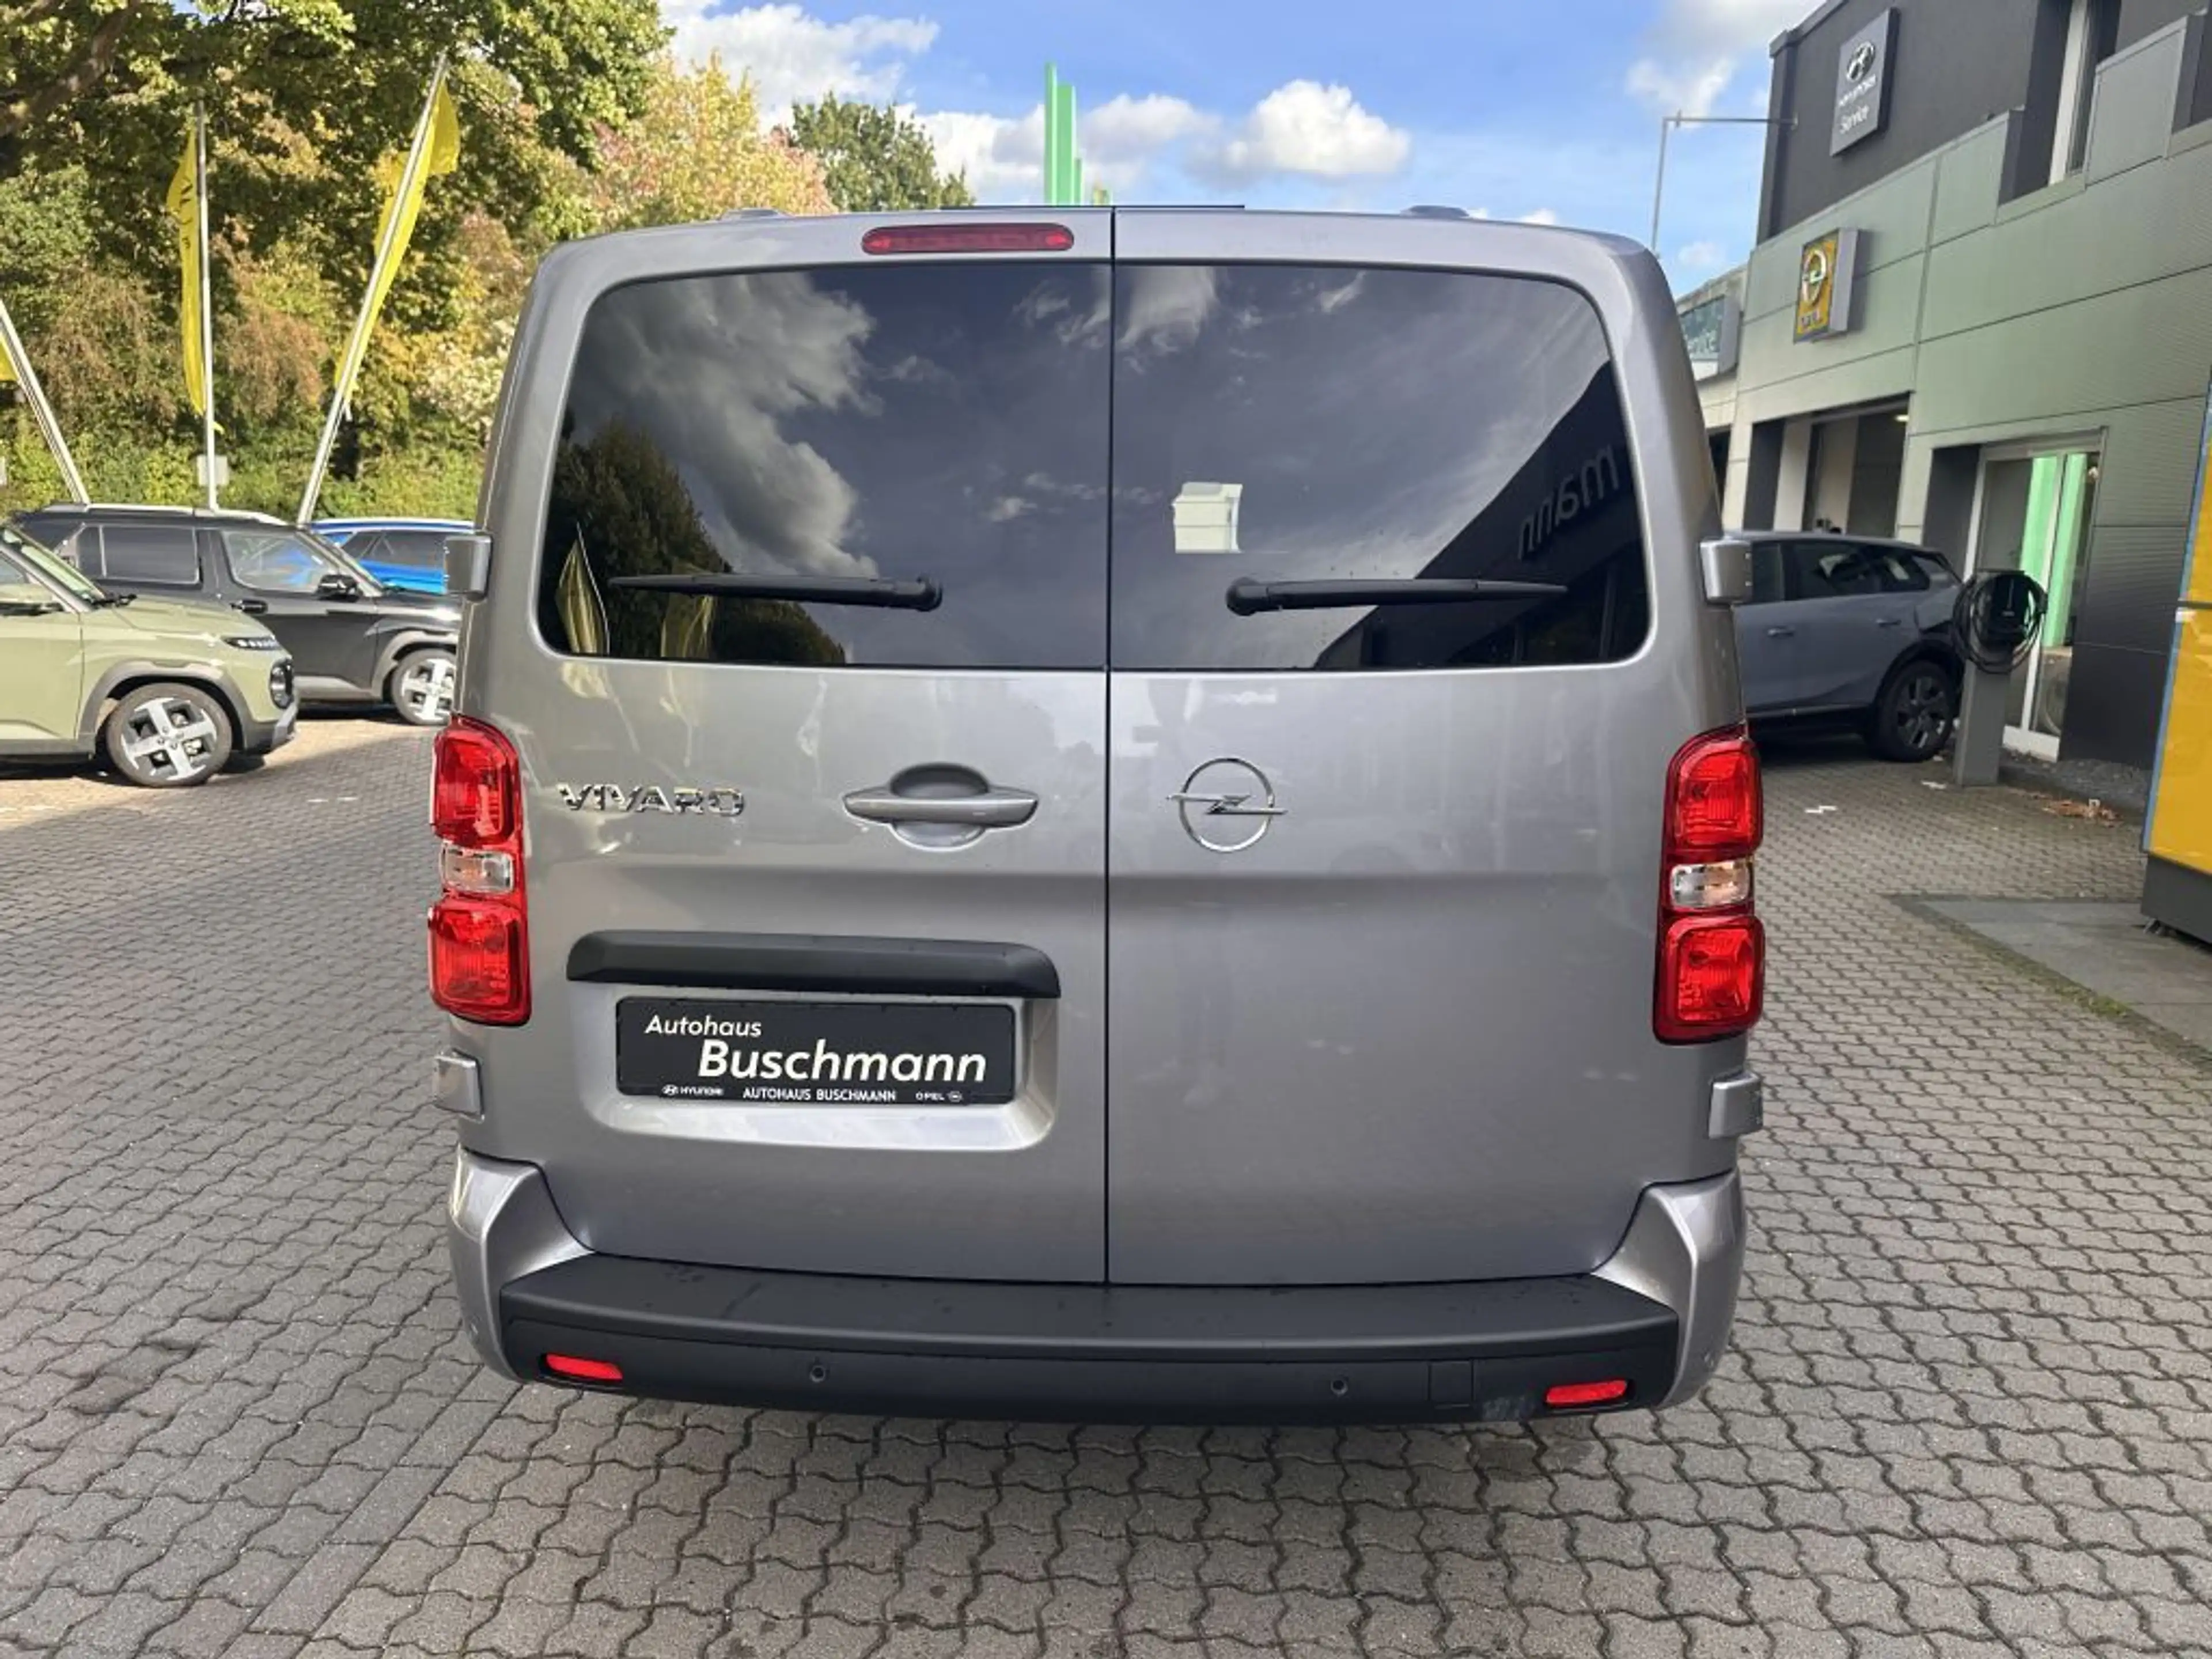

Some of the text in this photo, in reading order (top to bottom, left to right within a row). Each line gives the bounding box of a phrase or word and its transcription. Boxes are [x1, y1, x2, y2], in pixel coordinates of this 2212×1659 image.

[556, 783, 744, 816] VIVARO
[644, 1014, 762, 1037] Autohaus
[698, 1039, 986, 1082] Buschmann
[743, 1087, 896, 1101] AUTOHAUS BUSCHMANN
